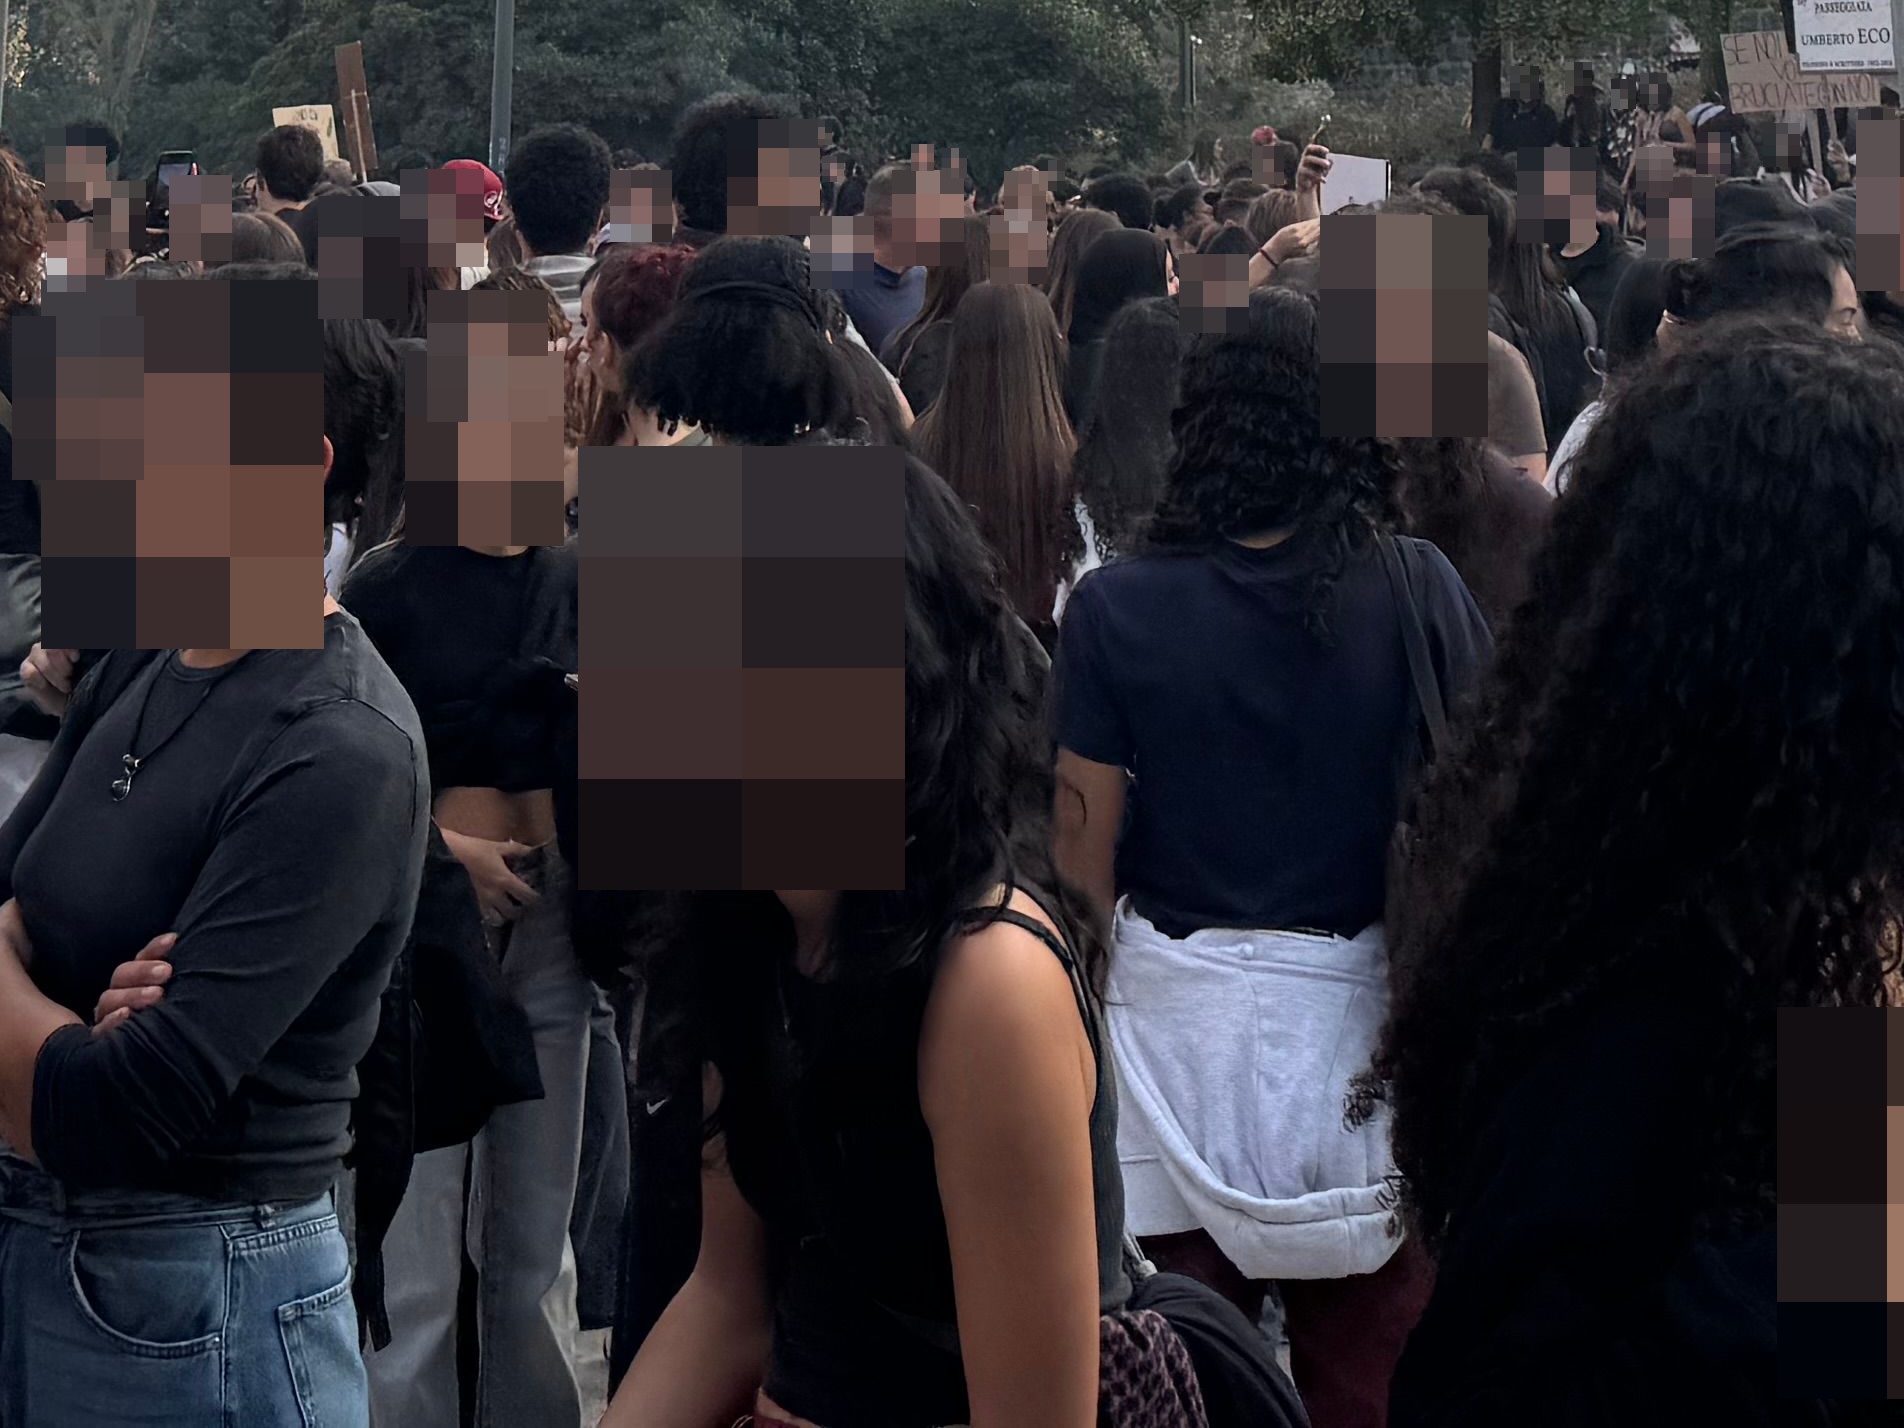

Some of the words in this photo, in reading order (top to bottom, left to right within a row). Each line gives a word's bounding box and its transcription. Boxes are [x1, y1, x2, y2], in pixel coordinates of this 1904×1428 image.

[1723, 33, 1748, 65] SE
[1752, 32, 1784, 63] NOI
[1800, 33, 1855, 46] UMBERTO
[1857, 27, 1891, 44] ECO
[1730, 81, 1817, 109] BRUCIATE
